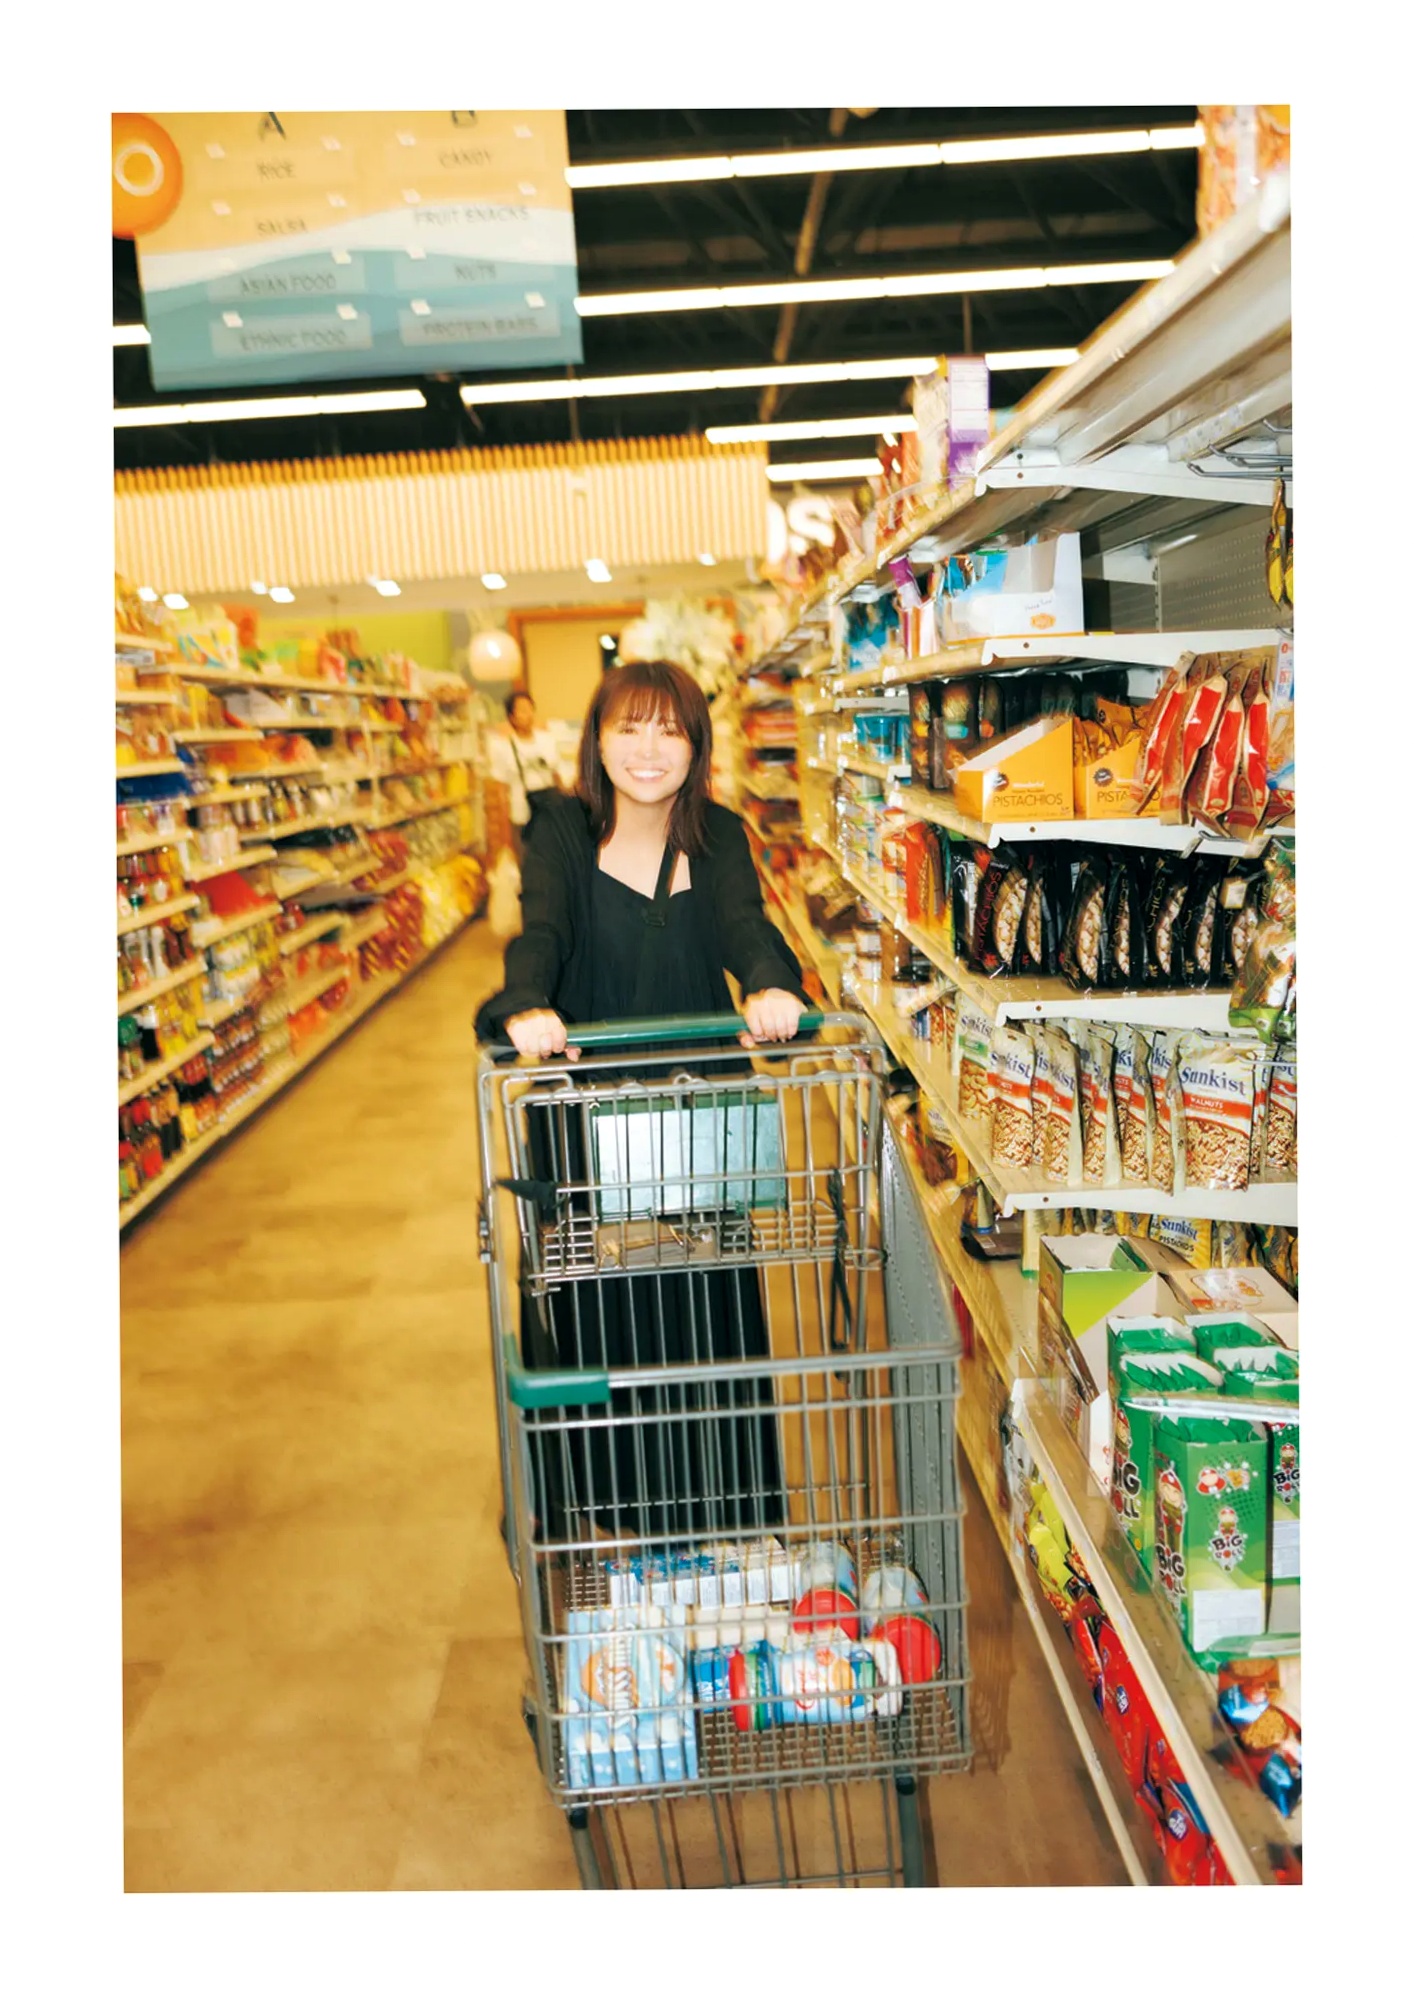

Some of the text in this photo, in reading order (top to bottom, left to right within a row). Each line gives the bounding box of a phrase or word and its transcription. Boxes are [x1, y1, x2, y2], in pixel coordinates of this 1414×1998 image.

[438, 149, 492, 168] CANDY
[256, 160, 296, 180] RICE
[413, 205, 530, 226] FRUIT SNACKS
[256, 219, 308, 236] SALSA
[454, 263, 496, 281] NUTS
[239, 272, 337, 296] ASIAN FOOD
[301, 328, 347, 346] FOOD
[993, 793, 1063, 807] PISTACHIOS
[1181, 1066, 1247, 1096] Sunkist
[1190, 1096, 1224, 1108] WALNUTS
[1161, 1218, 1198, 1241] Sunkist
